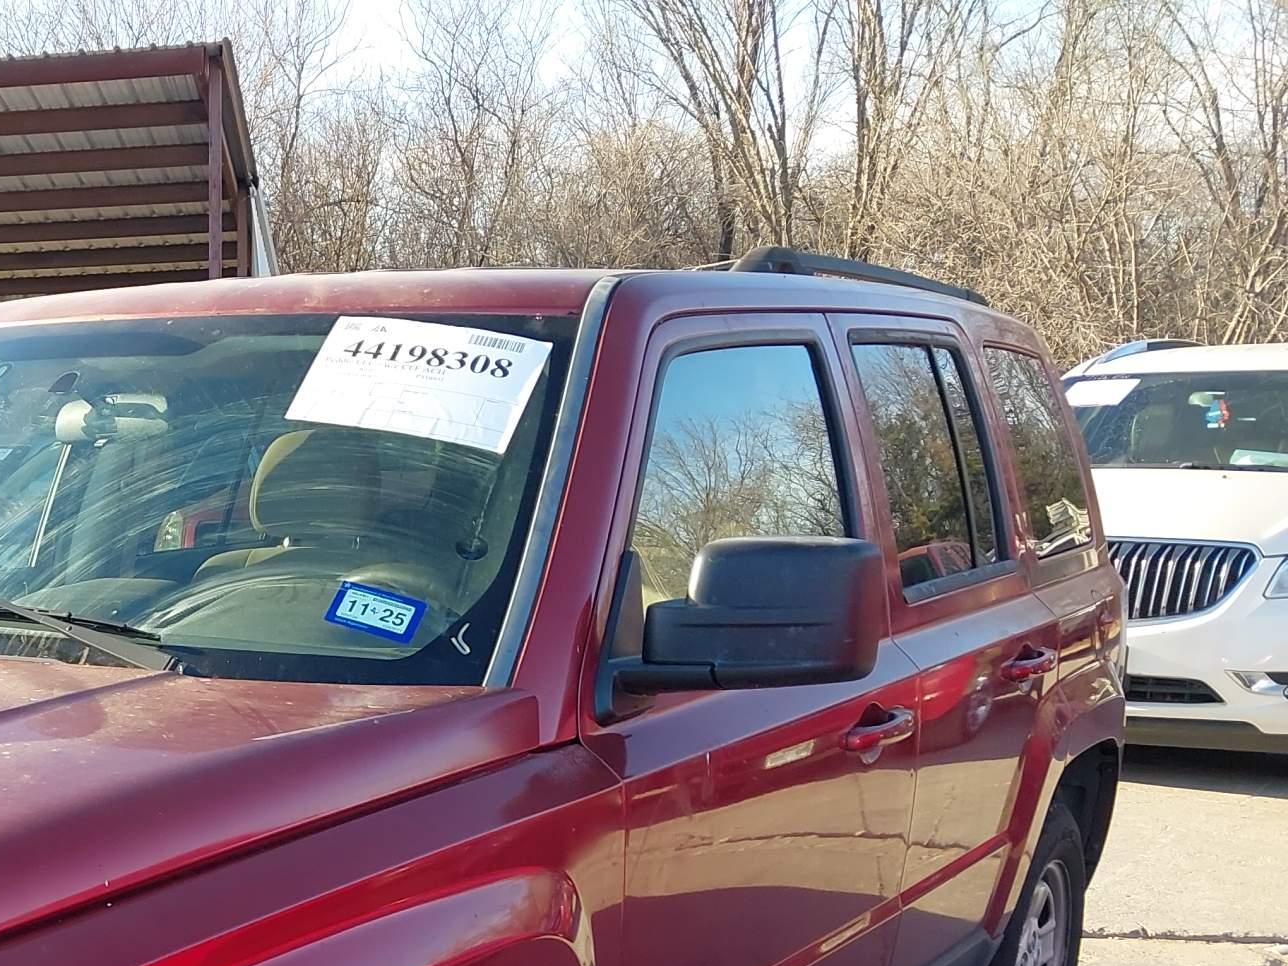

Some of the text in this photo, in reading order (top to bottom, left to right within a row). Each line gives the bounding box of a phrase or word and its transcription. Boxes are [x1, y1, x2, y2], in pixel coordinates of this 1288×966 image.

[343, 339, 513, 379] 44198308
[347, 599, 370, 617] 11
[379, 608, 407, 627] 25
